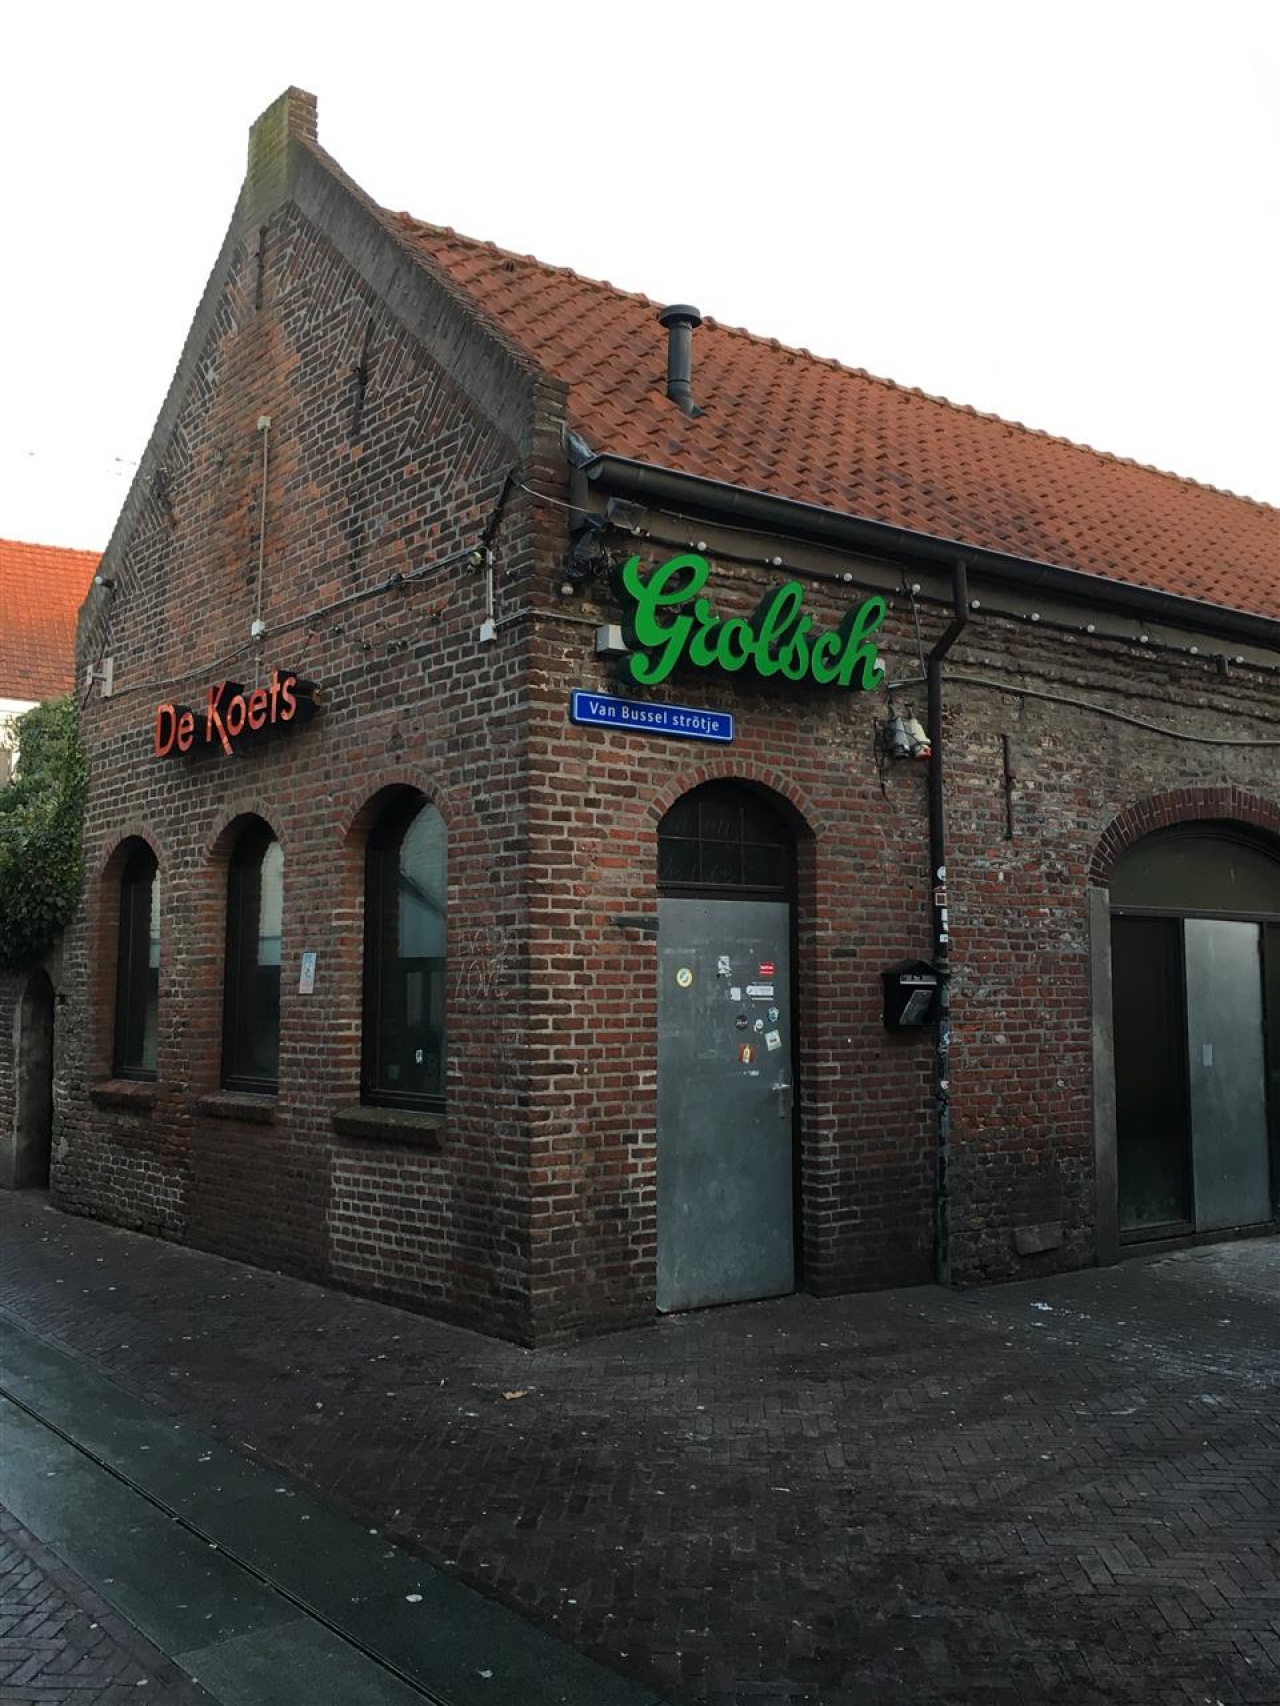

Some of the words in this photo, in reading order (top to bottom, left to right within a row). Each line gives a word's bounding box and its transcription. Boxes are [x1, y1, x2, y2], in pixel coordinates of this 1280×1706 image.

[623, 553, 887, 691] Grolsch
[155, 703, 194, 758] De
[205, 668, 297, 756] Koets
[589, 700, 616, 717] Van
[621, 706, 668, 724] Bussel
